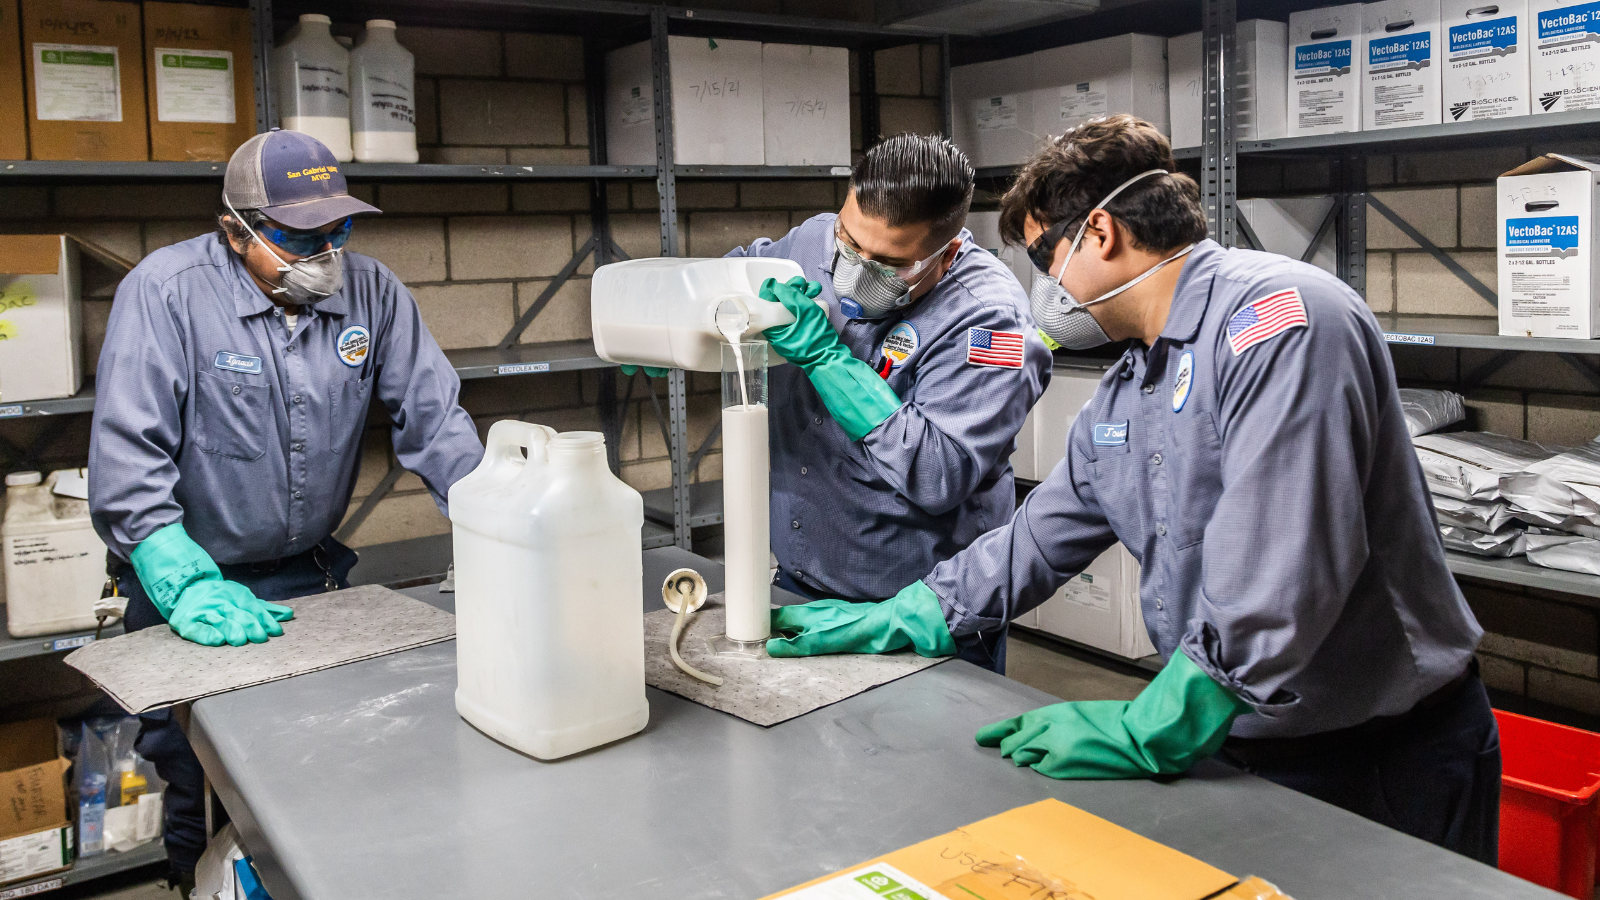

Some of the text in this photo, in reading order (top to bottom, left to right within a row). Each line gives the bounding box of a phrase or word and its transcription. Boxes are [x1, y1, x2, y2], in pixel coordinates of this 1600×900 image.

[1541, 13, 1588, 29] VectoBac
[1452, 25, 1516, 43] VectoBac 12AS
[1297, 48, 1350, 61] VectoBac 12AS
[1372, 40, 1429, 56] VectoBac 12AS
[1571, 44, 1591, 52] BOTTLES
[287, 171, 301, 179] San
[302, 166, 326, 176] Gabriel
[311, 173, 331, 181] MVCD
[1508, 225, 1578, 237] VectoBac 12AS
[940, 847, 998, 875] USE
[1003, 873, 1075, 900] FIR
